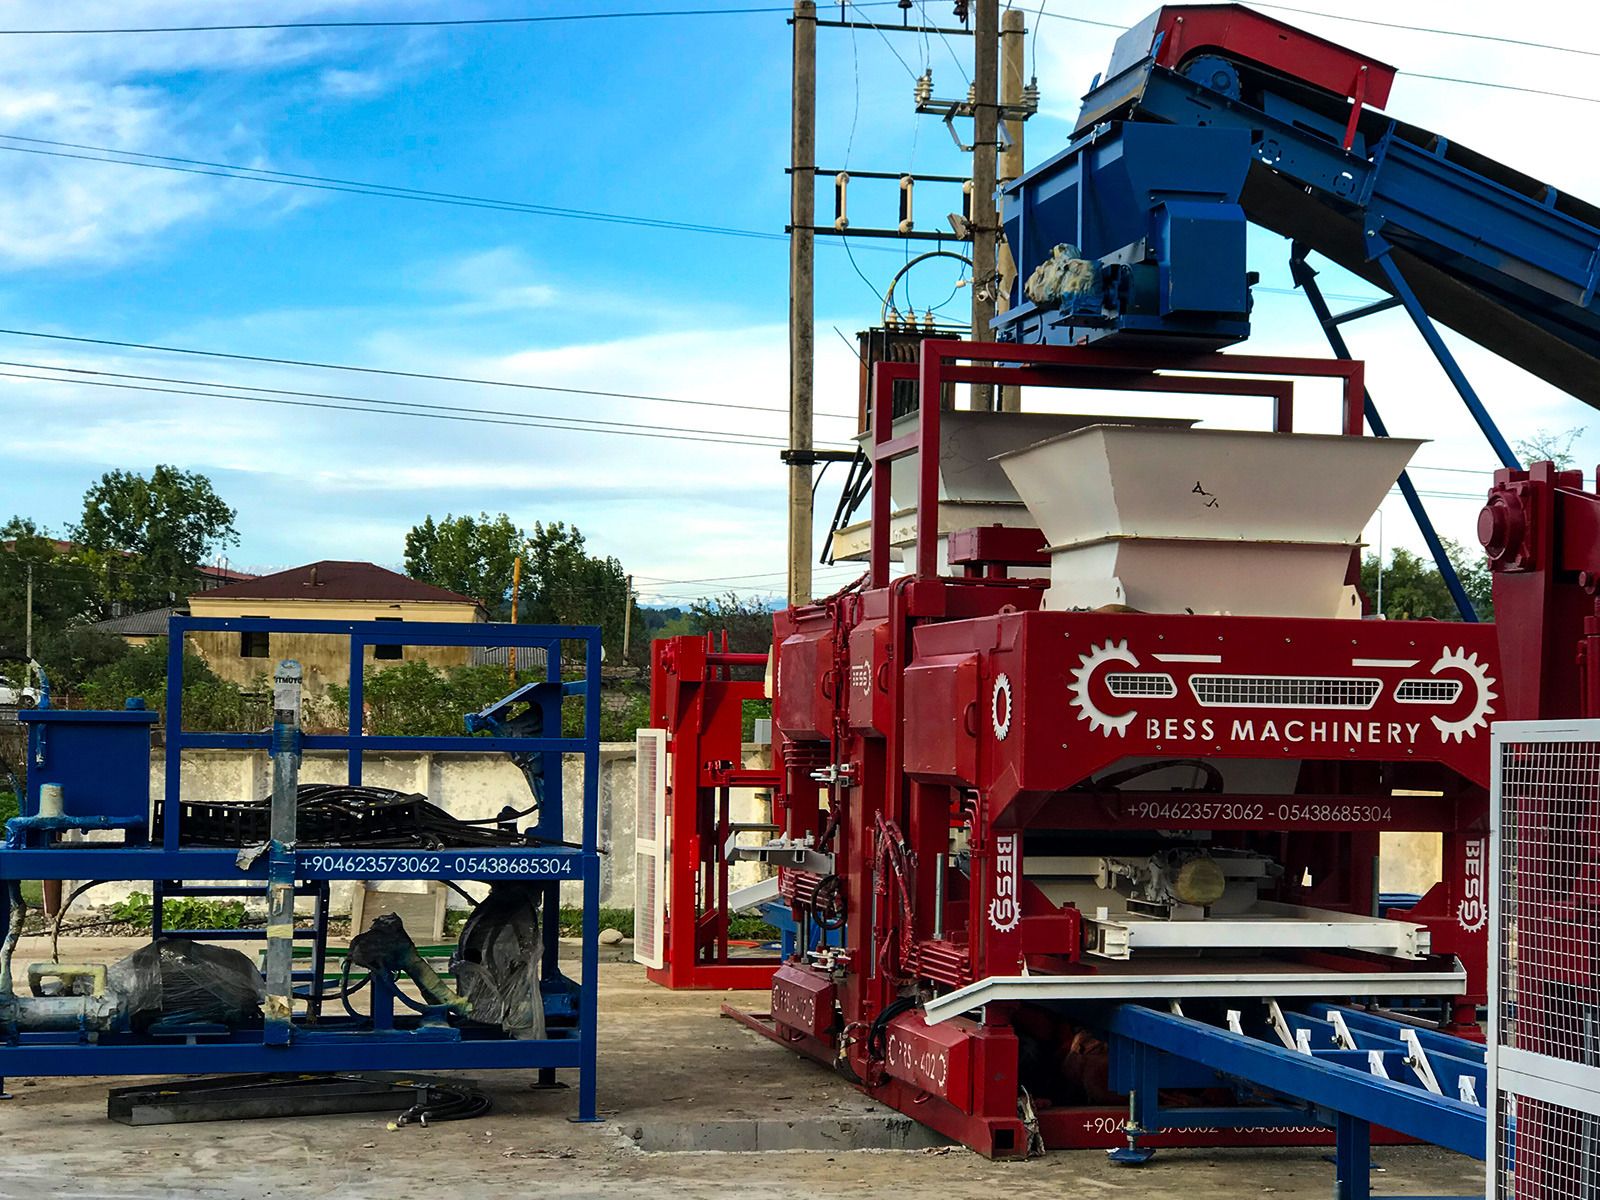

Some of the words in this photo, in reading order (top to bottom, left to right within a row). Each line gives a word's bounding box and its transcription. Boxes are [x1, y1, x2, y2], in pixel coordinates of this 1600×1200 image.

[1146, 718, 1215, 741] BESS
[1230, 719, 1421, 744] MACHINERY
[1127, 802, 1264, 820] +904623573062
[1278, 804, 1392, 822] 05438685304
[300, 856, 440, 874] +904623573062
[455, 858, 571, 874] 05438685304
[996, 836, 1012, 920] BESS
[1464, 840, 1480, 921] BESS
